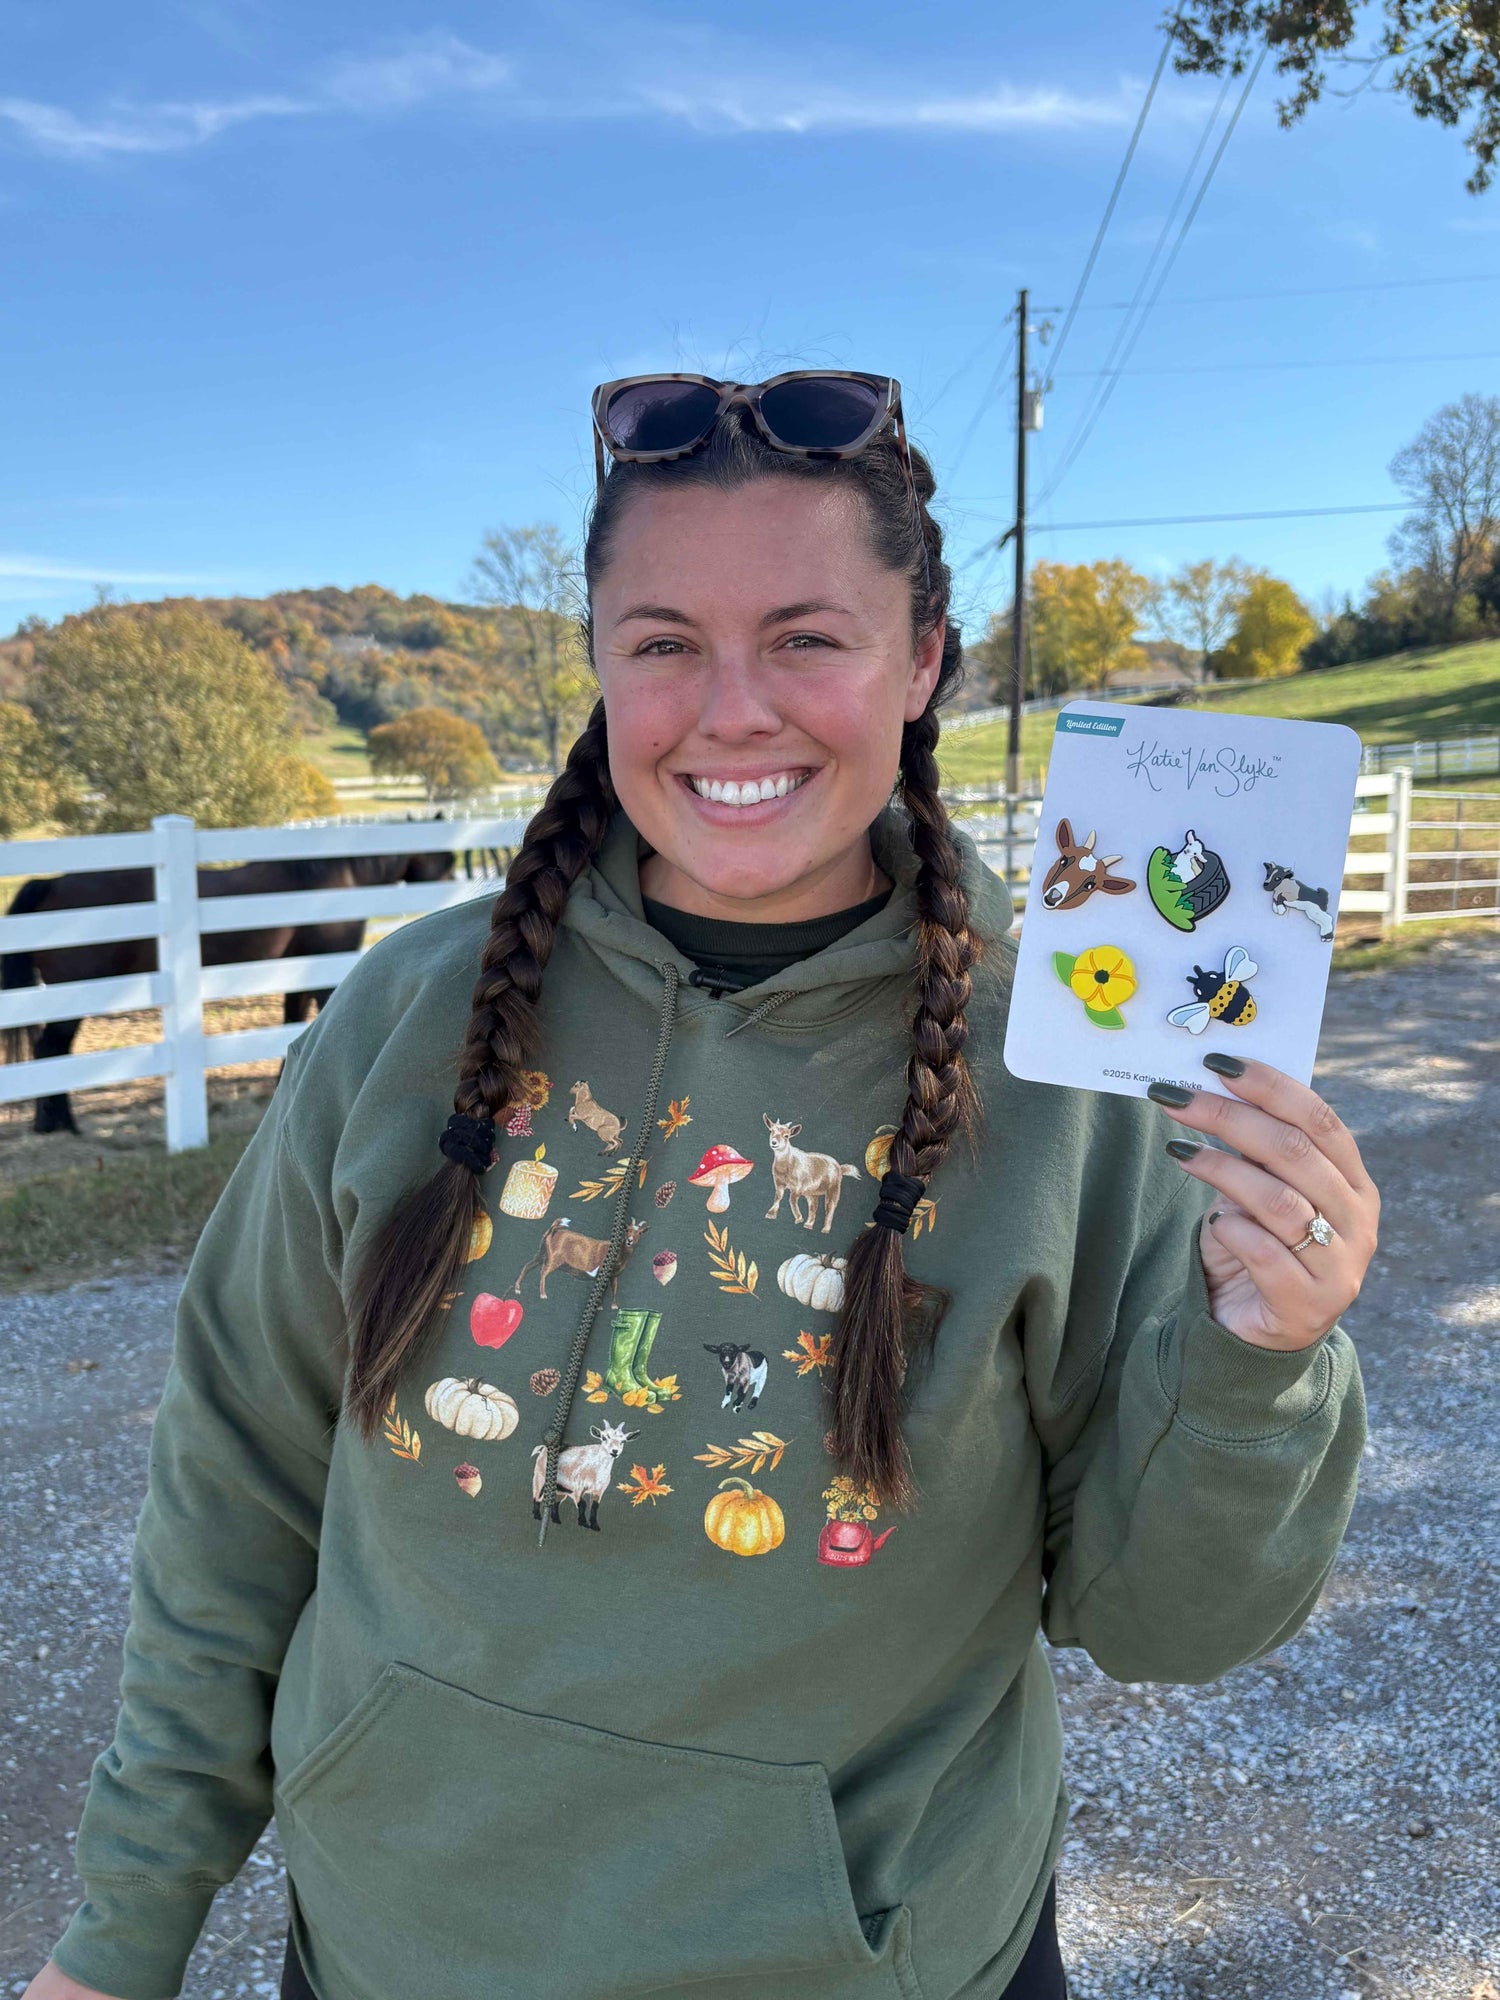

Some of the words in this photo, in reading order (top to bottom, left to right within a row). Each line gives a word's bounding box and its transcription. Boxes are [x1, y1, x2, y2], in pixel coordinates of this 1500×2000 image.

[1066, 719, 1091, 729] Limited
[1092, 722, 1117, 732] Edition
[1126, 740, 1183, 792] Katie
[1102, 1068, 1131, 1080] ©2025
[1133, 1073, 1157, 1083] Katie
